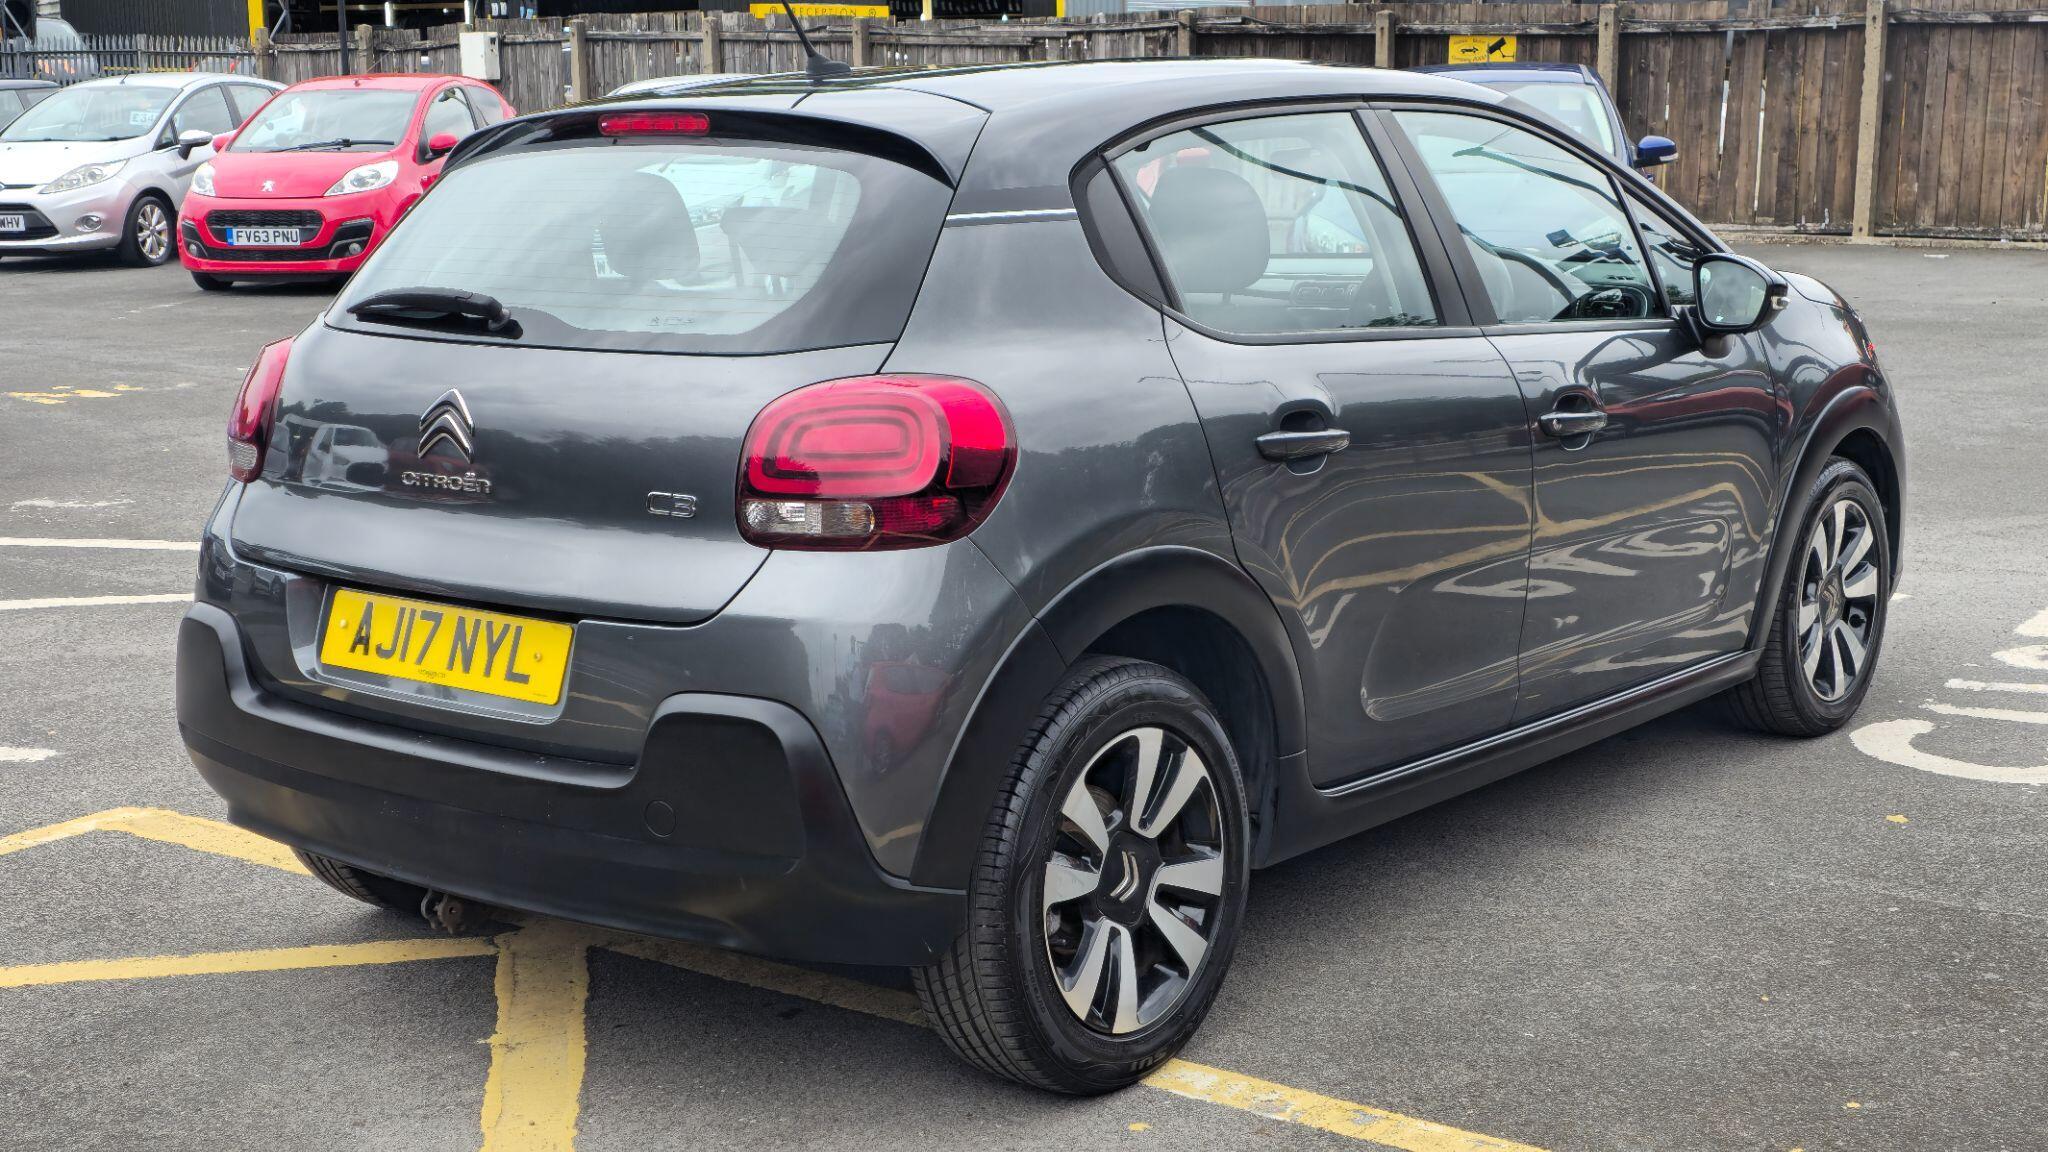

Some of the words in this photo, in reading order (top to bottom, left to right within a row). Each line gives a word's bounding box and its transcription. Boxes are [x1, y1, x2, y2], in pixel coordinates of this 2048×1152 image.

[236, 230, 269, 243] FV63
[273, 230, 299, 243] PNU
[646, 491, 696, 518] C3
[349, 601, 443, 666] AJ17
[446, 615, 530, 684] NYL
